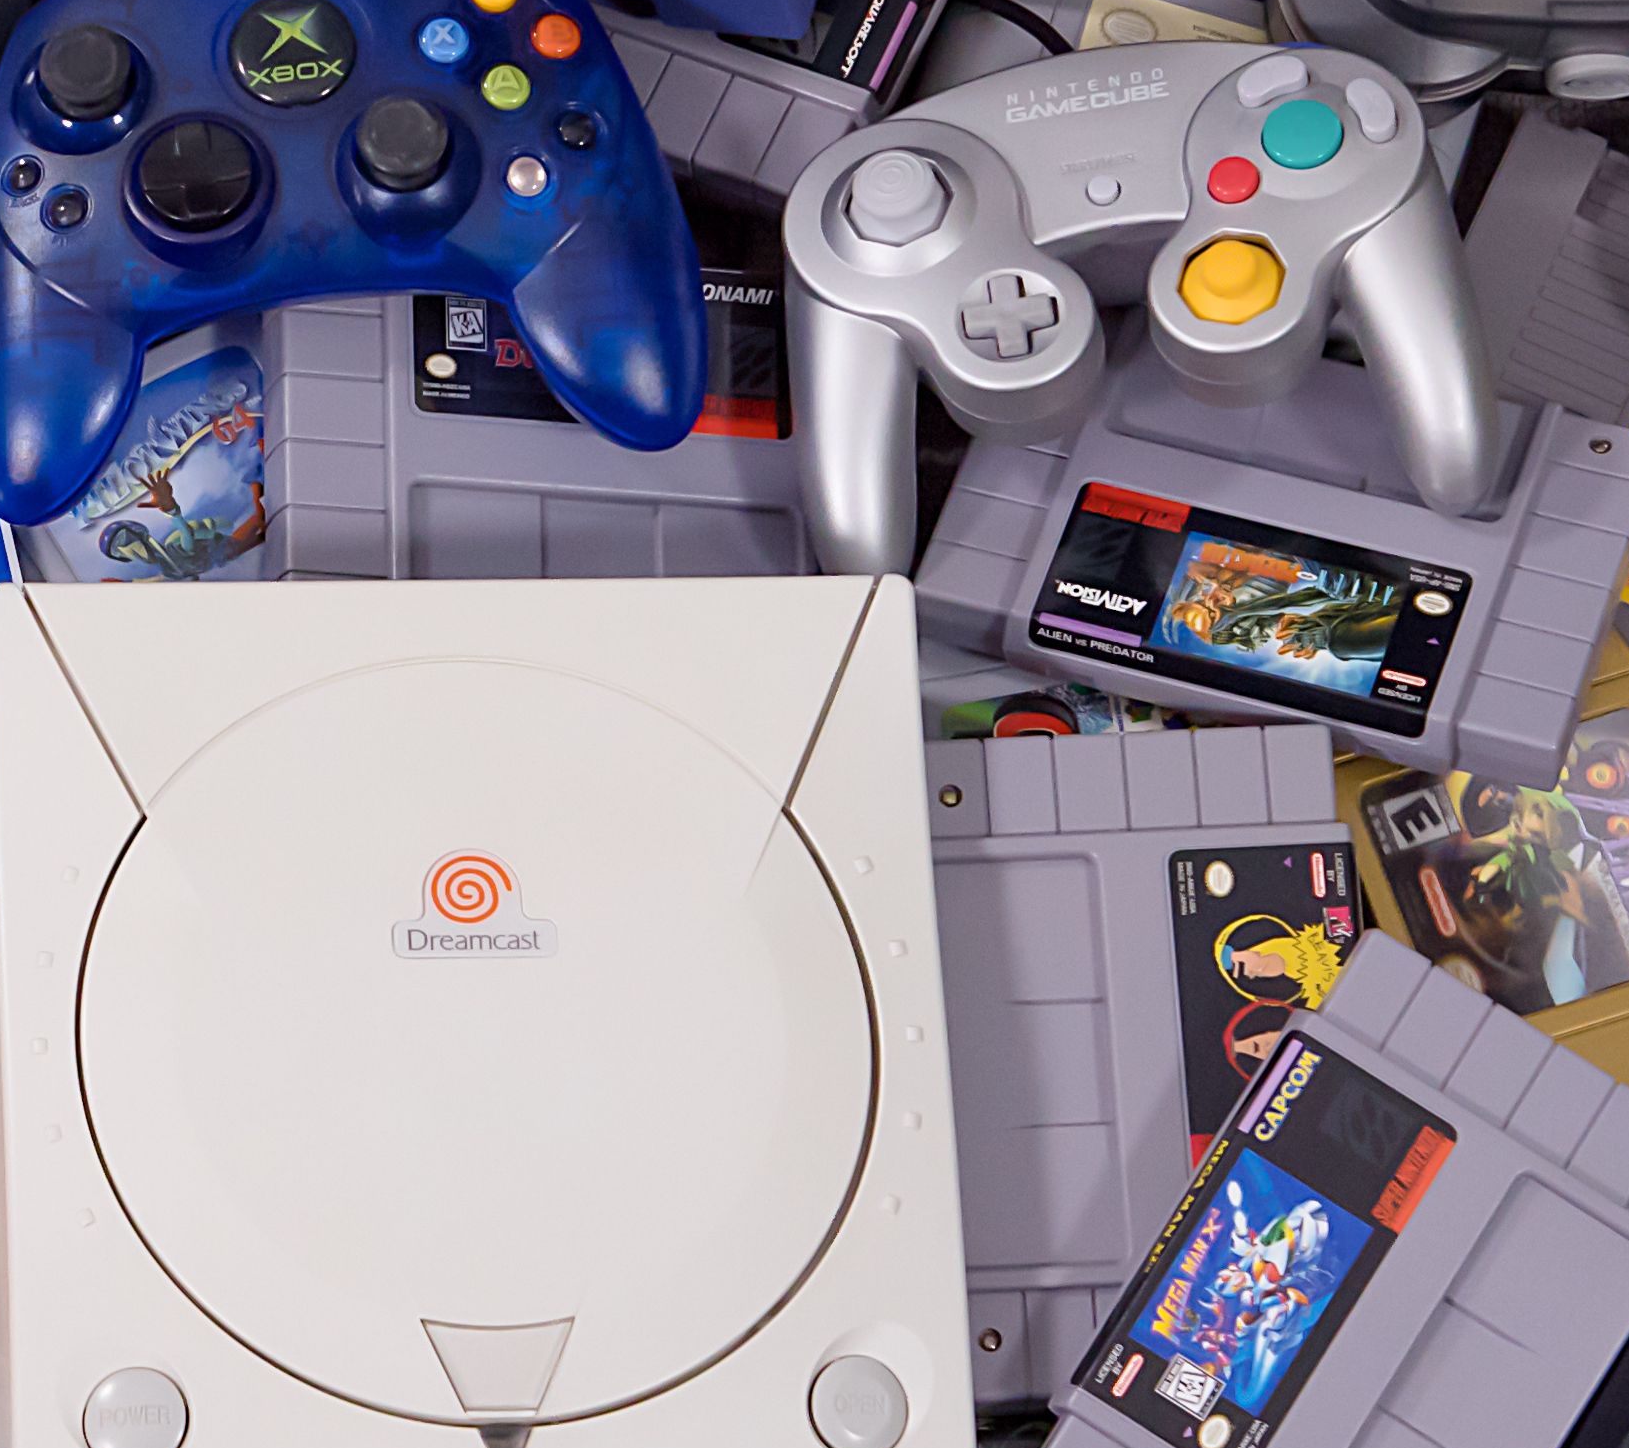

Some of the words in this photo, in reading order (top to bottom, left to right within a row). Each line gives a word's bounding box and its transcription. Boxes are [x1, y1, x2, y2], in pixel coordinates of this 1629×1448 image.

[248, 57, 343, 87] XBOX
[1005, 70, 1163, 103] NINTENDO
[1005, 80, 1168, 123] GAMECUBE
[1056, 581, 1147, 615] ACTIVISION
[1037, 627, 1071, 644] ALIEN
[1090, 640, 1153, 663] PREDATOR
[407, 927, 540, 953] Dreamcast
[1252, 1051, 1321, 1143] CAPCOM
